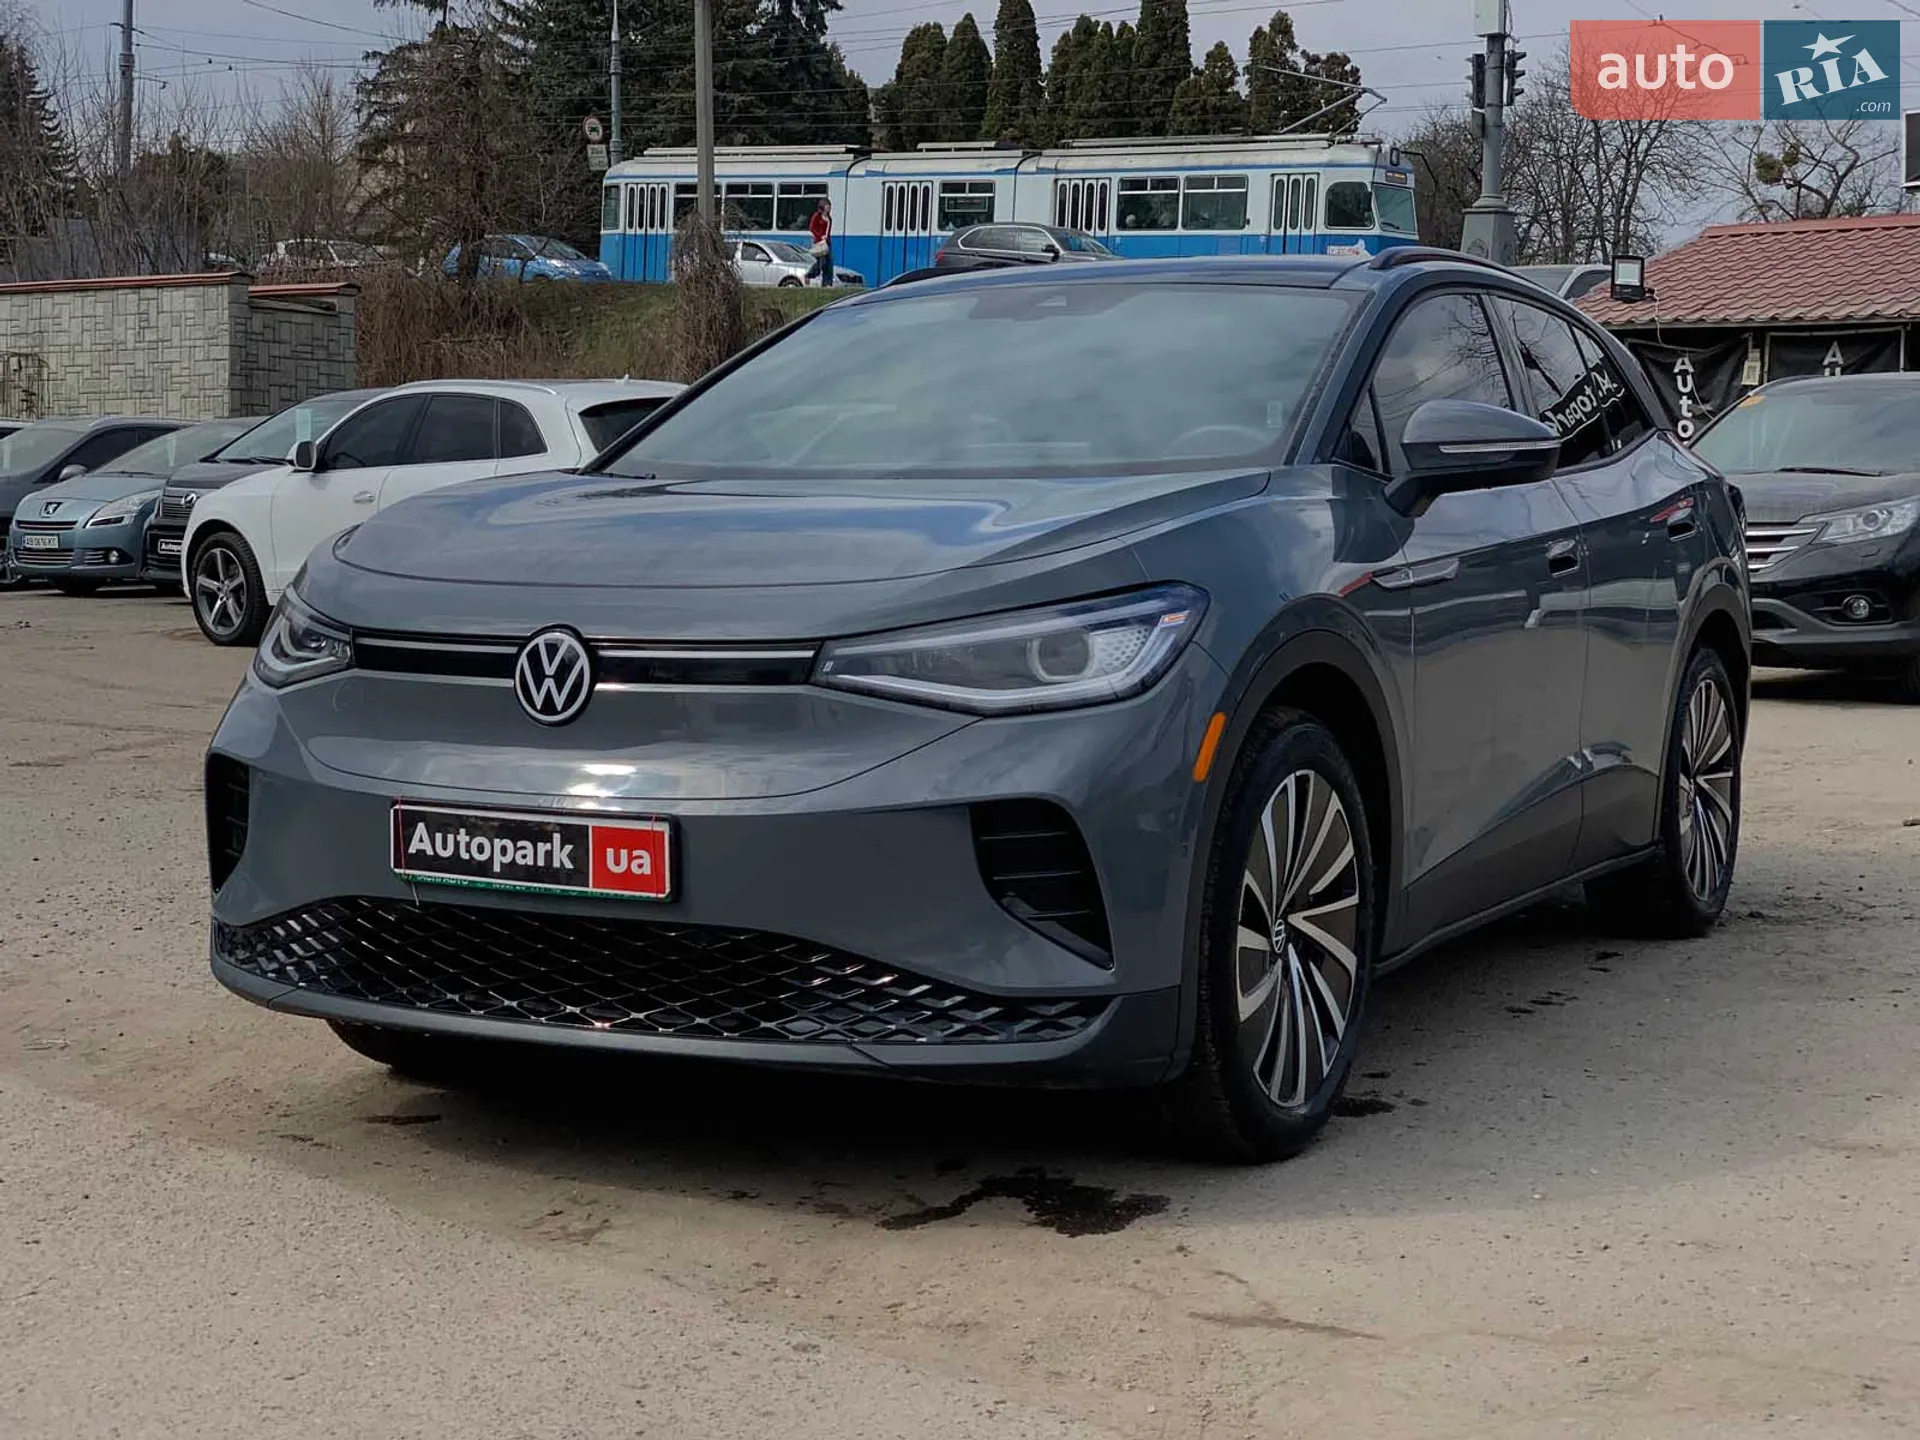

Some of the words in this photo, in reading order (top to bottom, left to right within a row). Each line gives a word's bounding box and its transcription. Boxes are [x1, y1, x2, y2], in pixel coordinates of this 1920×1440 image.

[517, 633, 590, 721] VW
[408, 822, 574, 873] Autopark
[605, 847, 651, 875] ua
